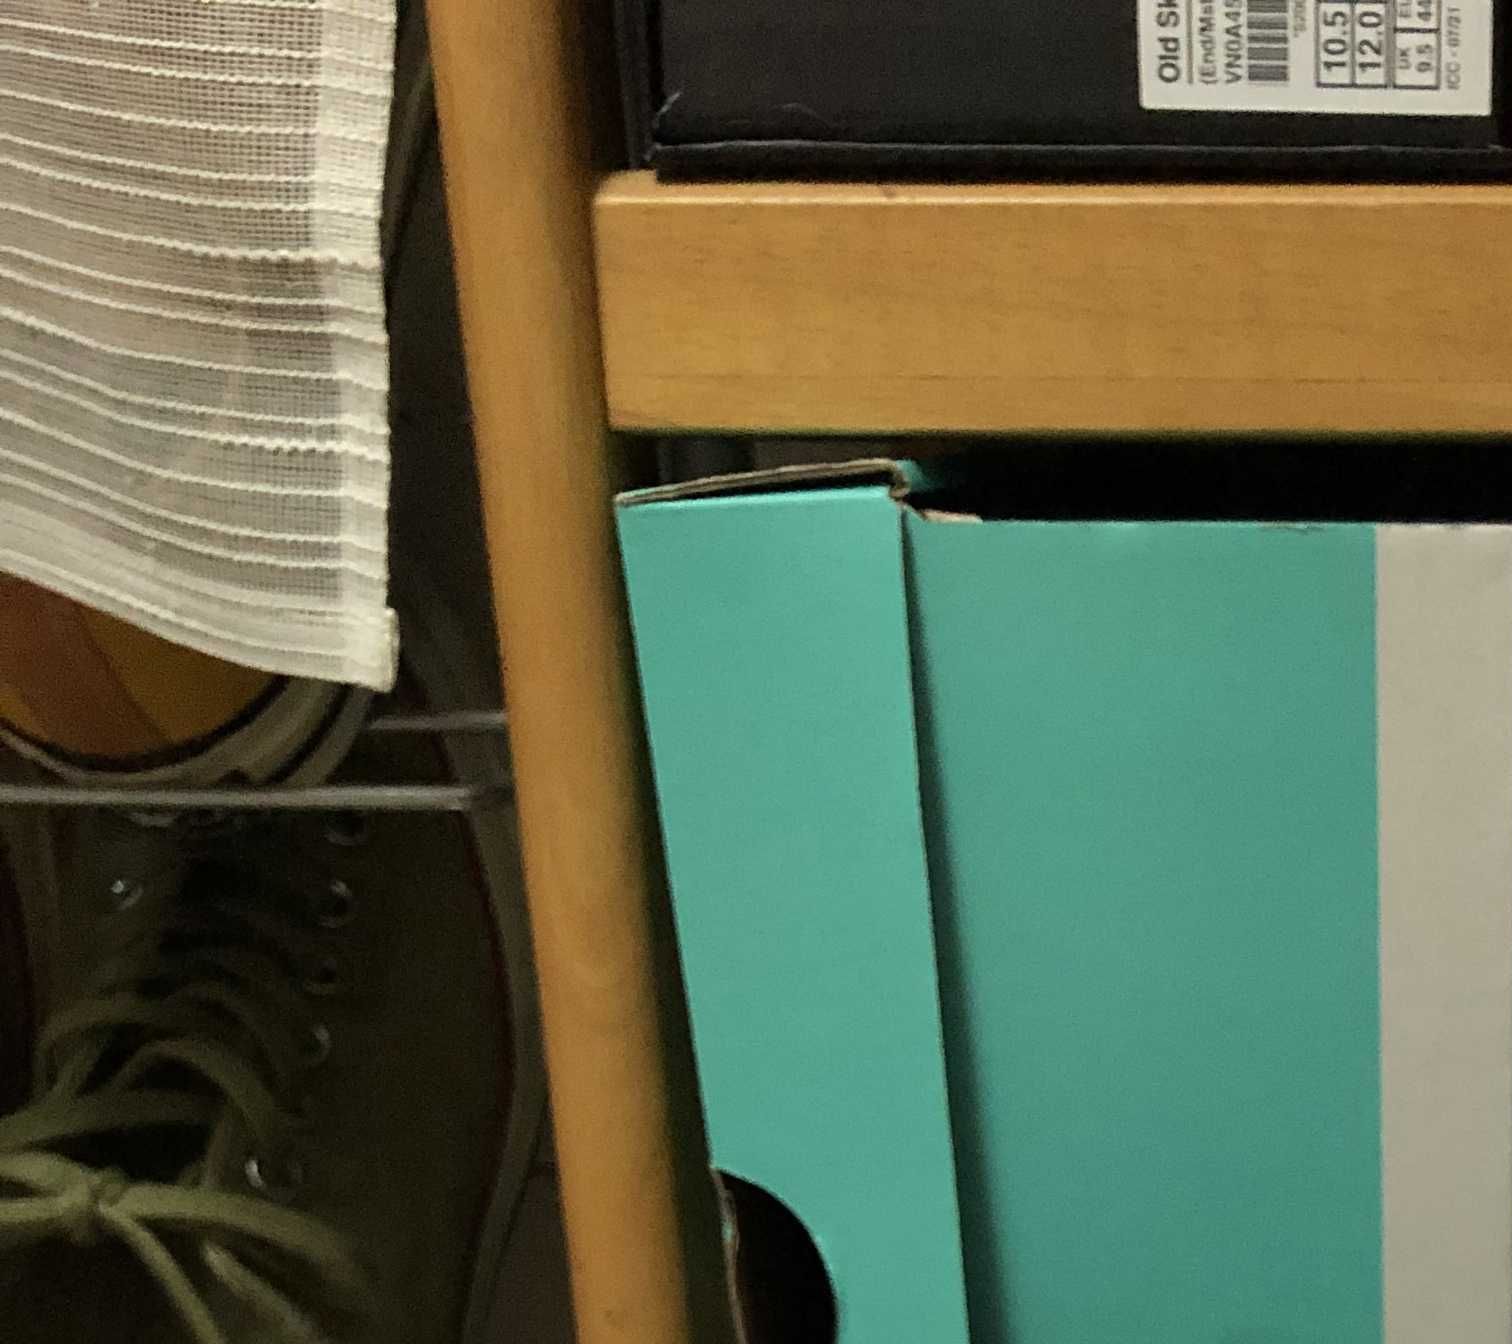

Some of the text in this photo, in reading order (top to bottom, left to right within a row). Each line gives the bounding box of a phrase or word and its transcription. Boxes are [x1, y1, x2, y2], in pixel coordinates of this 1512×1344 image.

[1157, 37, 1180, 83] Old
[1323, 11, 1348, 72] 10.5
[1358, 11, 1382, 73] 12.0
[1400, 48, 1412, 69] UK
[1415, 44, 1433, 73] 9.5
